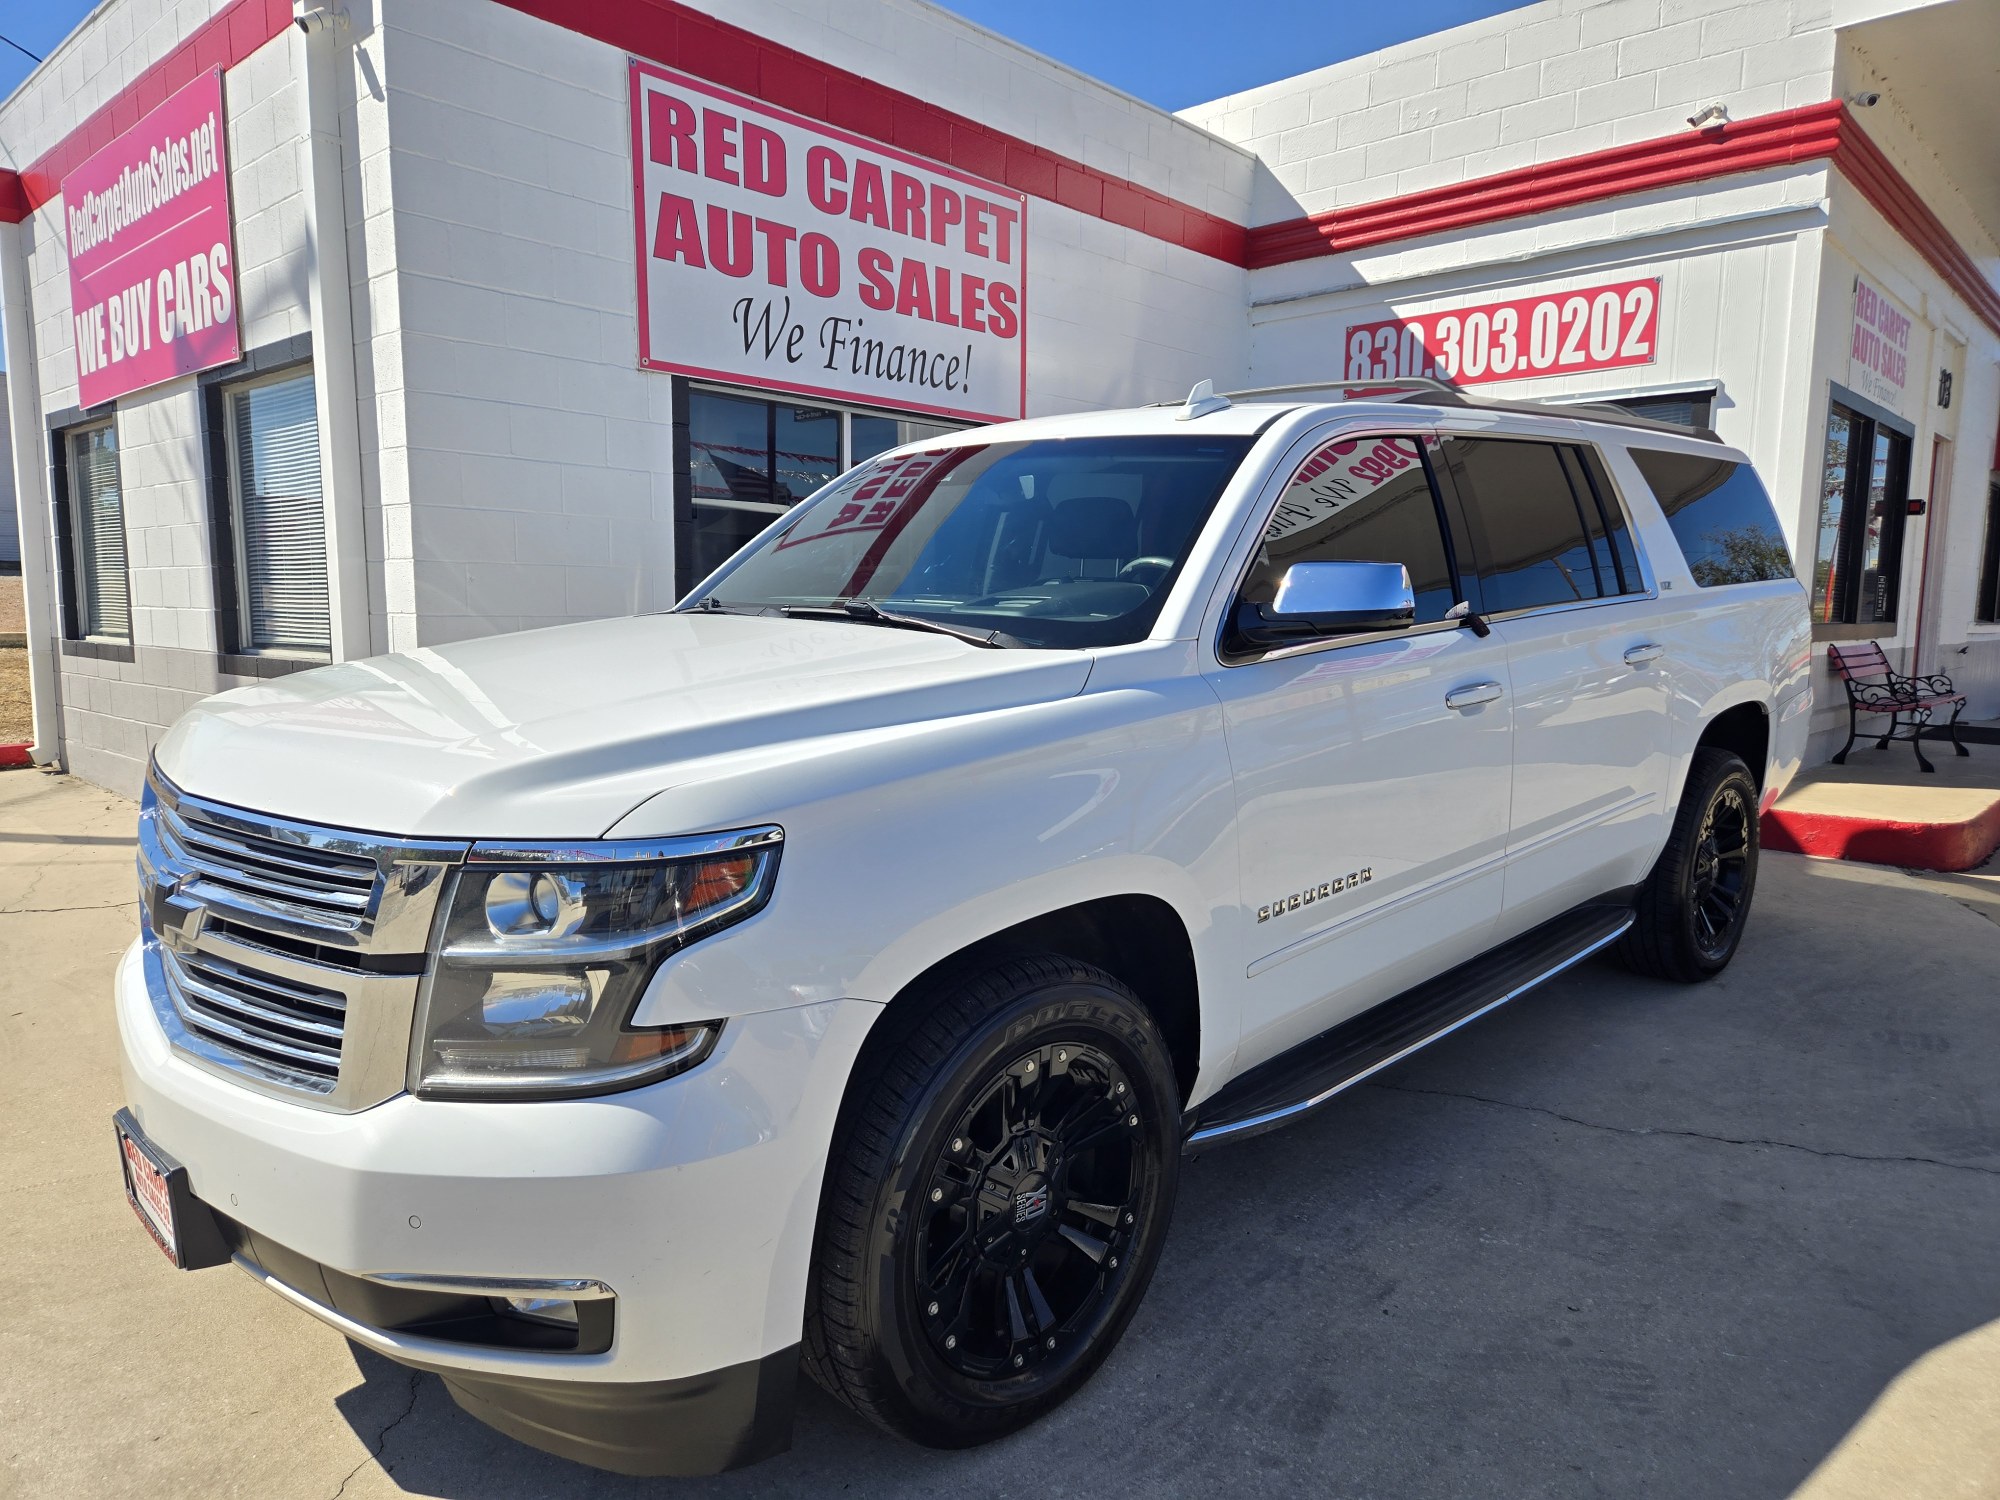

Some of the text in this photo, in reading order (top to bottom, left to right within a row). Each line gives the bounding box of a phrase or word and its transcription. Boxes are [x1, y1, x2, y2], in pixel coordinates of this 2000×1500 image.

[68, 111, 219, 259] RedCarpetAutoSales.net
[647, 88, 1018, 264] RED CARPET
[75, 242, 232, 376] WE BUY CARS
[653, 191, 1018, 339] AUTO SALES
[1855, 281, 1911, 351] RED CARPET
[732, 296, 973, 394] We Finance!
[1348, 286, 1654, 392] 830.303.0202
[1852, 323, 1880, 372] AUTO
[1880, 342, 1906, 389] SALES
[1257, 867, 1373, 924] SUBURBAN
[1015, 1193, 1027, 1222] SERIES
